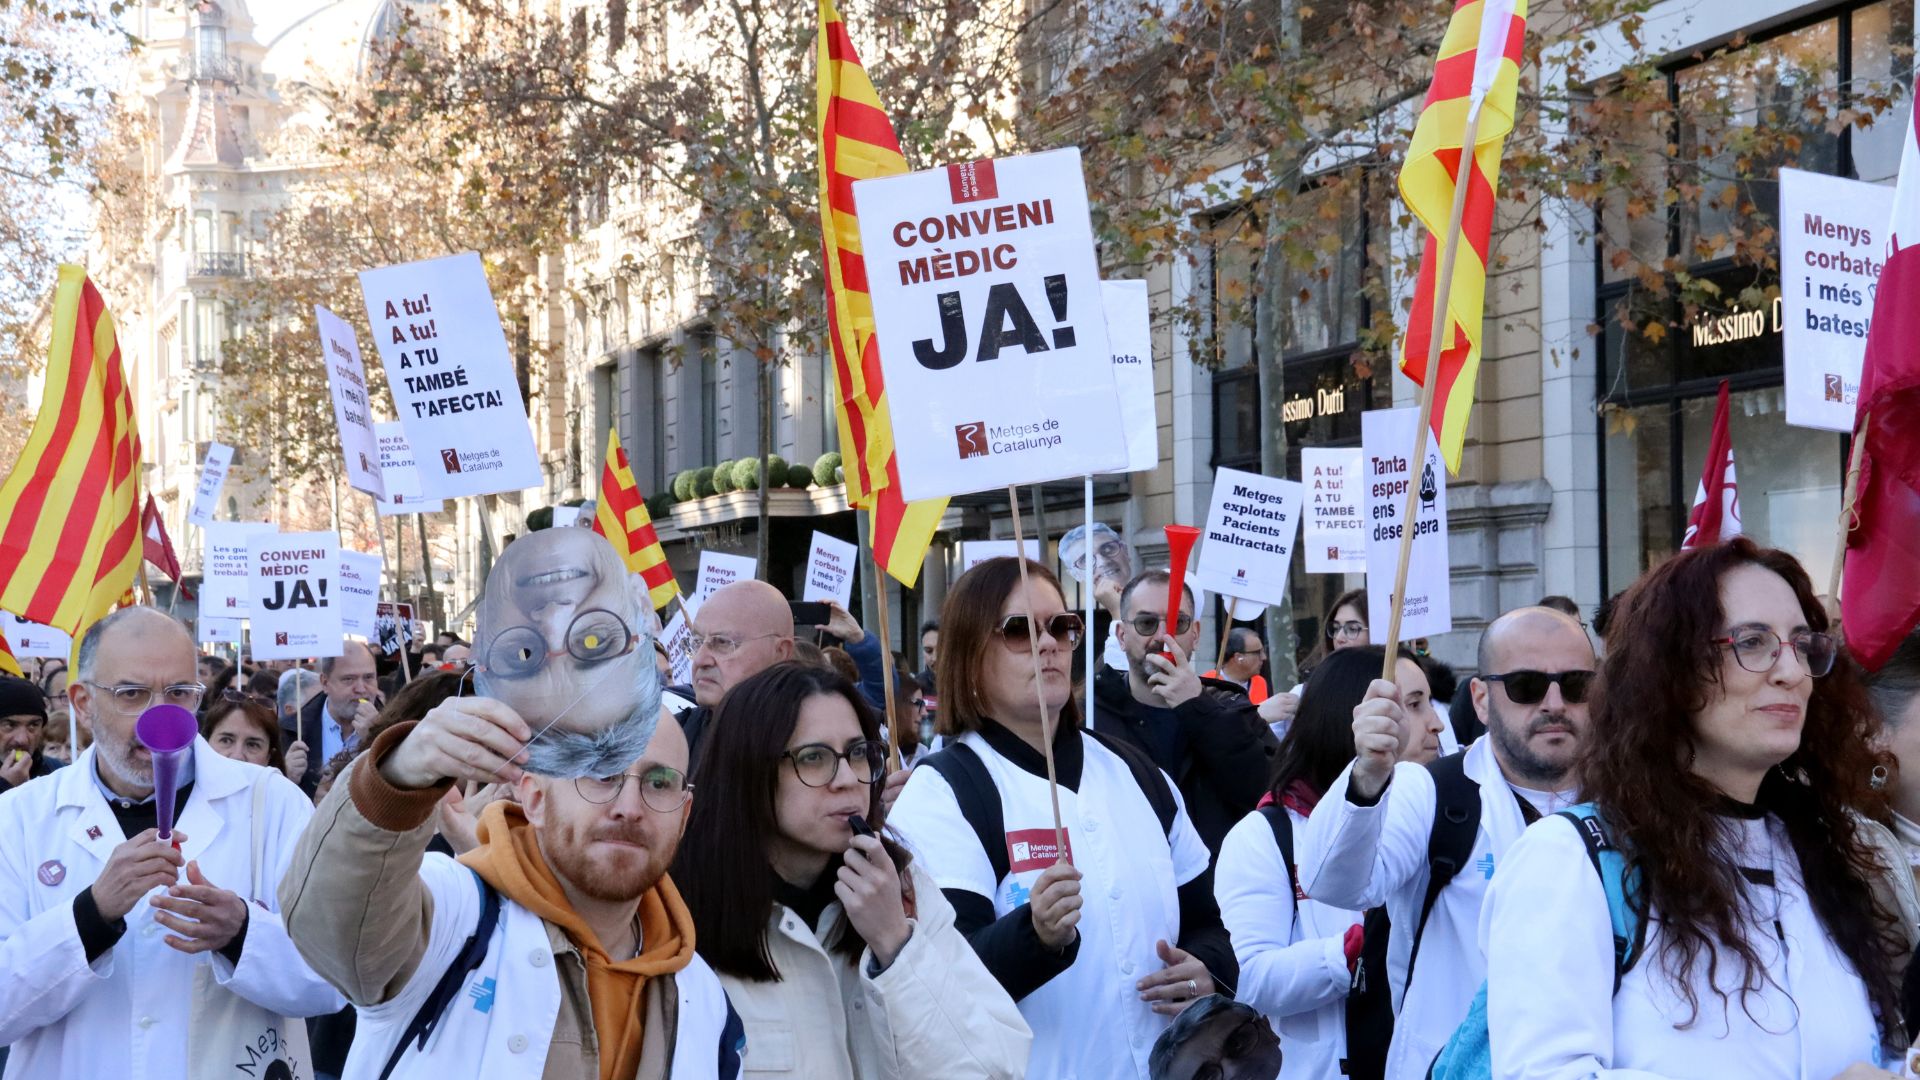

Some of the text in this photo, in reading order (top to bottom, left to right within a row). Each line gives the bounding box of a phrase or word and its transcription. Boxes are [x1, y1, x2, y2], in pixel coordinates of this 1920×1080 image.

[960, 162, 970, 198] atalunya
[968, 161, 977, 186] etges
[893, 198, 1054, 248] CONVENI
[1803, 213, 1871, 248] Menys
[898, 243, 1018, 286] MÈDIC
[1805, 276, 1862, 307] i més
[385, 294, 431, 320] A tu!
[392, 319, 438, 344] A tu!
[911, 273, 1077, 371] JA!
[1806, 308, 1869, 339] bates!
[400, 348, 439, 369] A TU
[404, 365, 469, 394] TAMBÉ
[412, 390, 503, 419] T'AFECTA!
[1283, 384, 1344, 422] ssimo Dutti
[989, 418, 1059, 441] Metges de
[992, 434, 1062, 455] Catalunya
[459, 449, 500, 464] Metges de
[462, 460, 503, 473] Catalunya
[1372, 456, 1407, 475] Tanta
[1314, 466, 1343, 476] A tu!
[1314, 479, 1344, 489] A tu!
[1233, 485, 1283, 505] Metges
[1315, 494, 1341, 503] A TU
[1223, 502, 1286, 521] explotats
[1315, 505, 1355, 516] TAMBÉ
[1373, 504, 1395, 520] ens
[1222, 515, 1280, 537] Pacients
[1374, 519, 1439, 542] desepera
[1209, 530, 1287, 555] maltractats
[260, 549, 325, 562] CONVENI
[816, 547, 840, 562] Menys
[260, 563, 309, 577] MÈDIC
[706, 565, 736, 577] Menys
[814, 559, 847, 576] corbates
[818, 571, 834, 581] més
[262, 579, 329, 611] JA!
[1030, 844, 1056, 852] Metges
